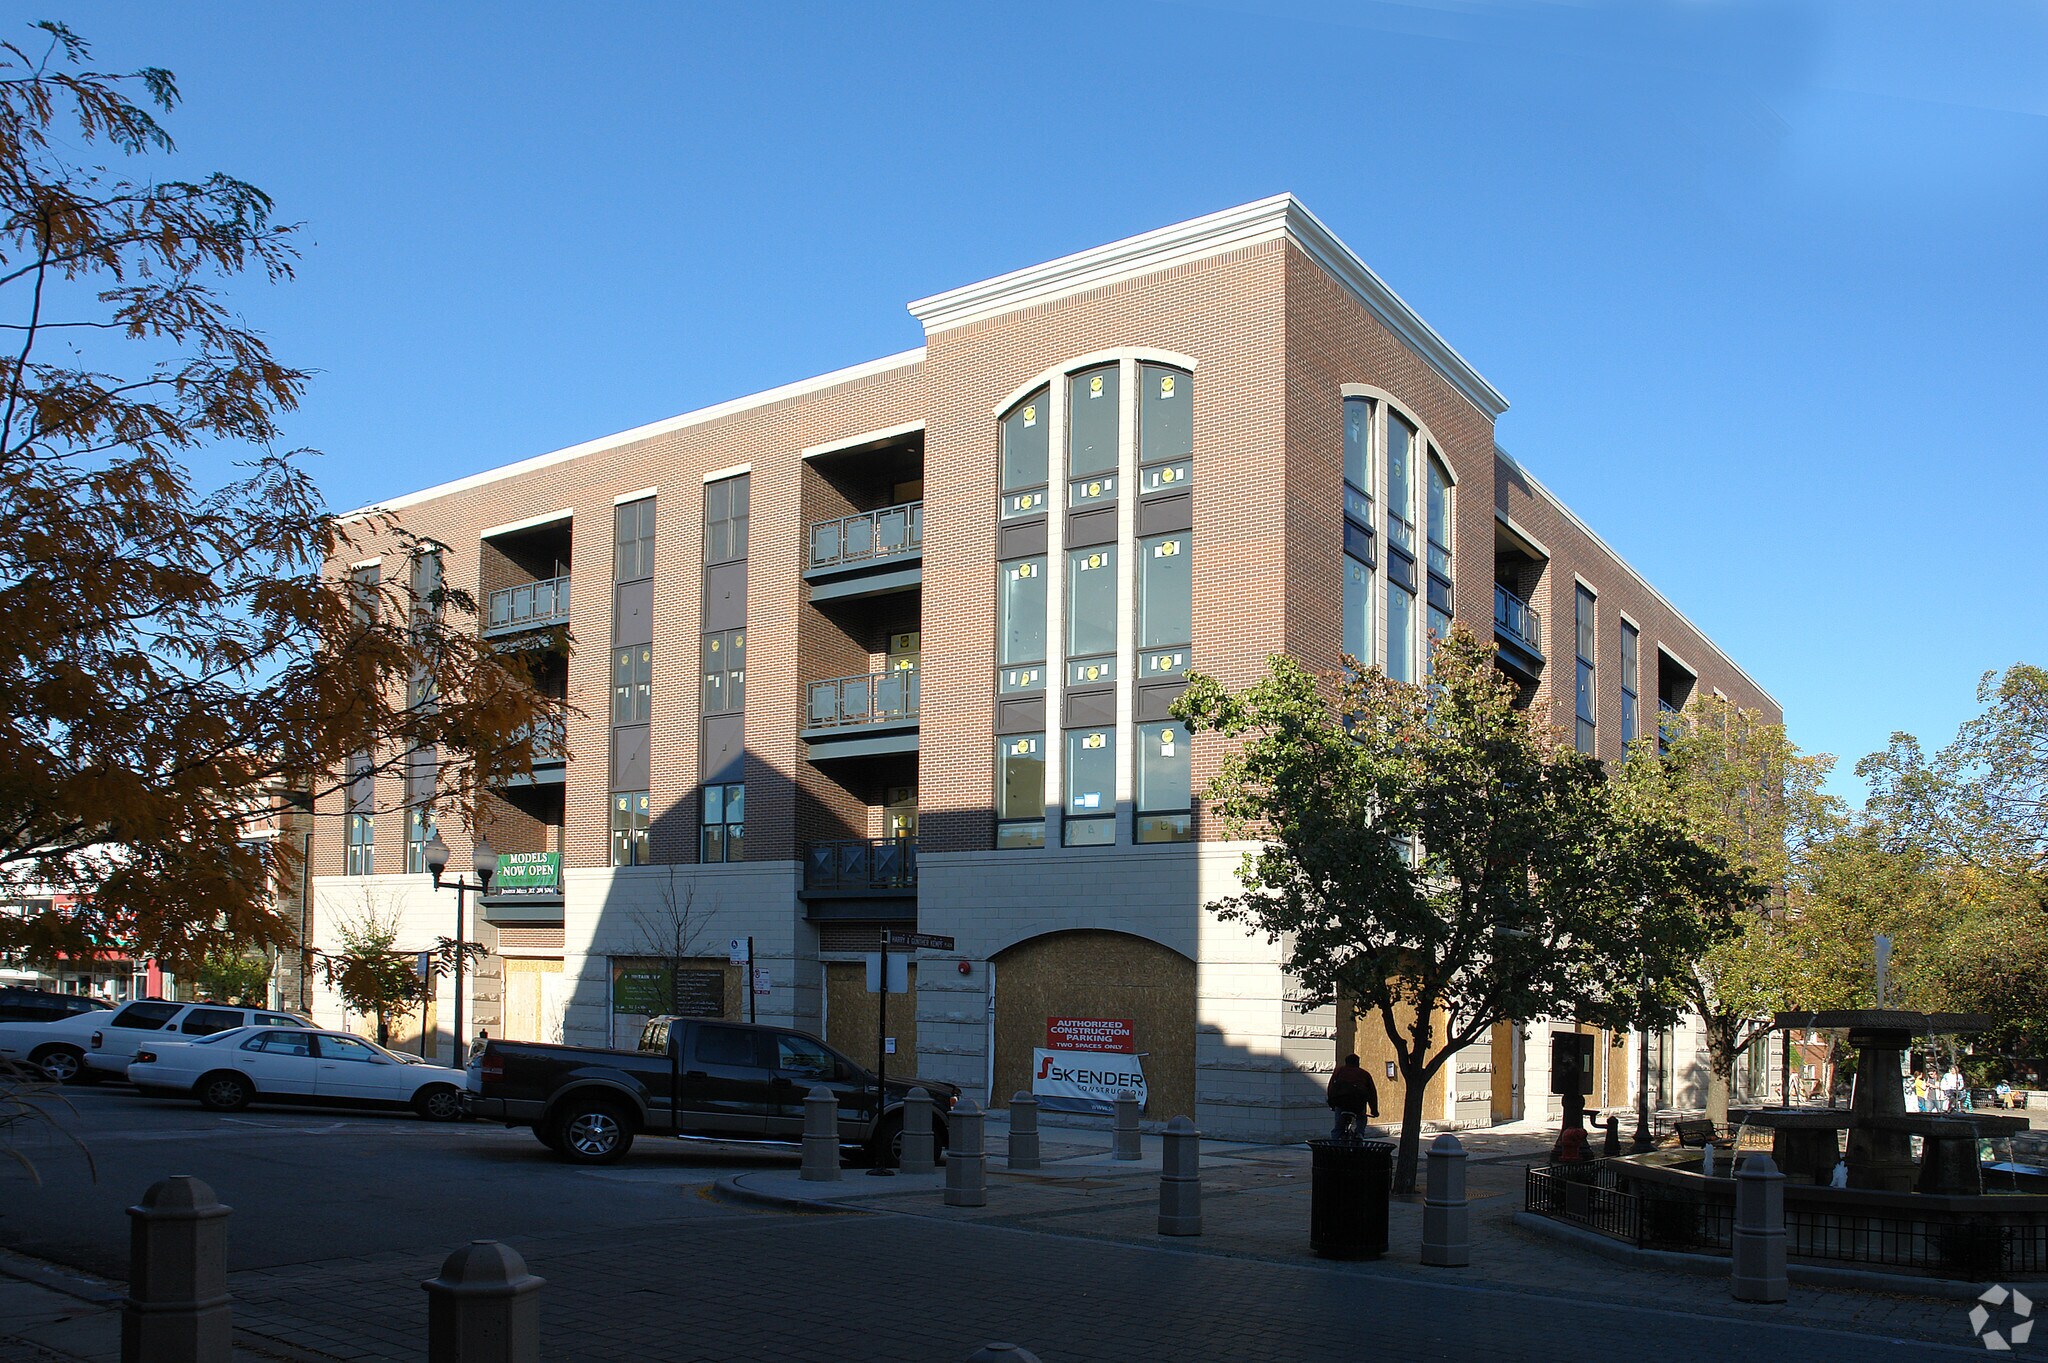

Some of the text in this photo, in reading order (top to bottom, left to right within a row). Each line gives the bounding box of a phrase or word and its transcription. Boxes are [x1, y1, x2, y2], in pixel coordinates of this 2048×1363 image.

[510, 852, 548, 864] MODELS
[502, 864, 554, 877] NOW OPEN
[1056, 1020, 1123, 1029] AUTHORIZED
[1050, 1026, 1130, 1036] CONSTRUCTION
[1066, 1034, 1113, 1042] PARKING
[1051, 1067, 1144, 1088] SKENDER
[1077, 1084, 1144, 1097] CONSTRUCON
